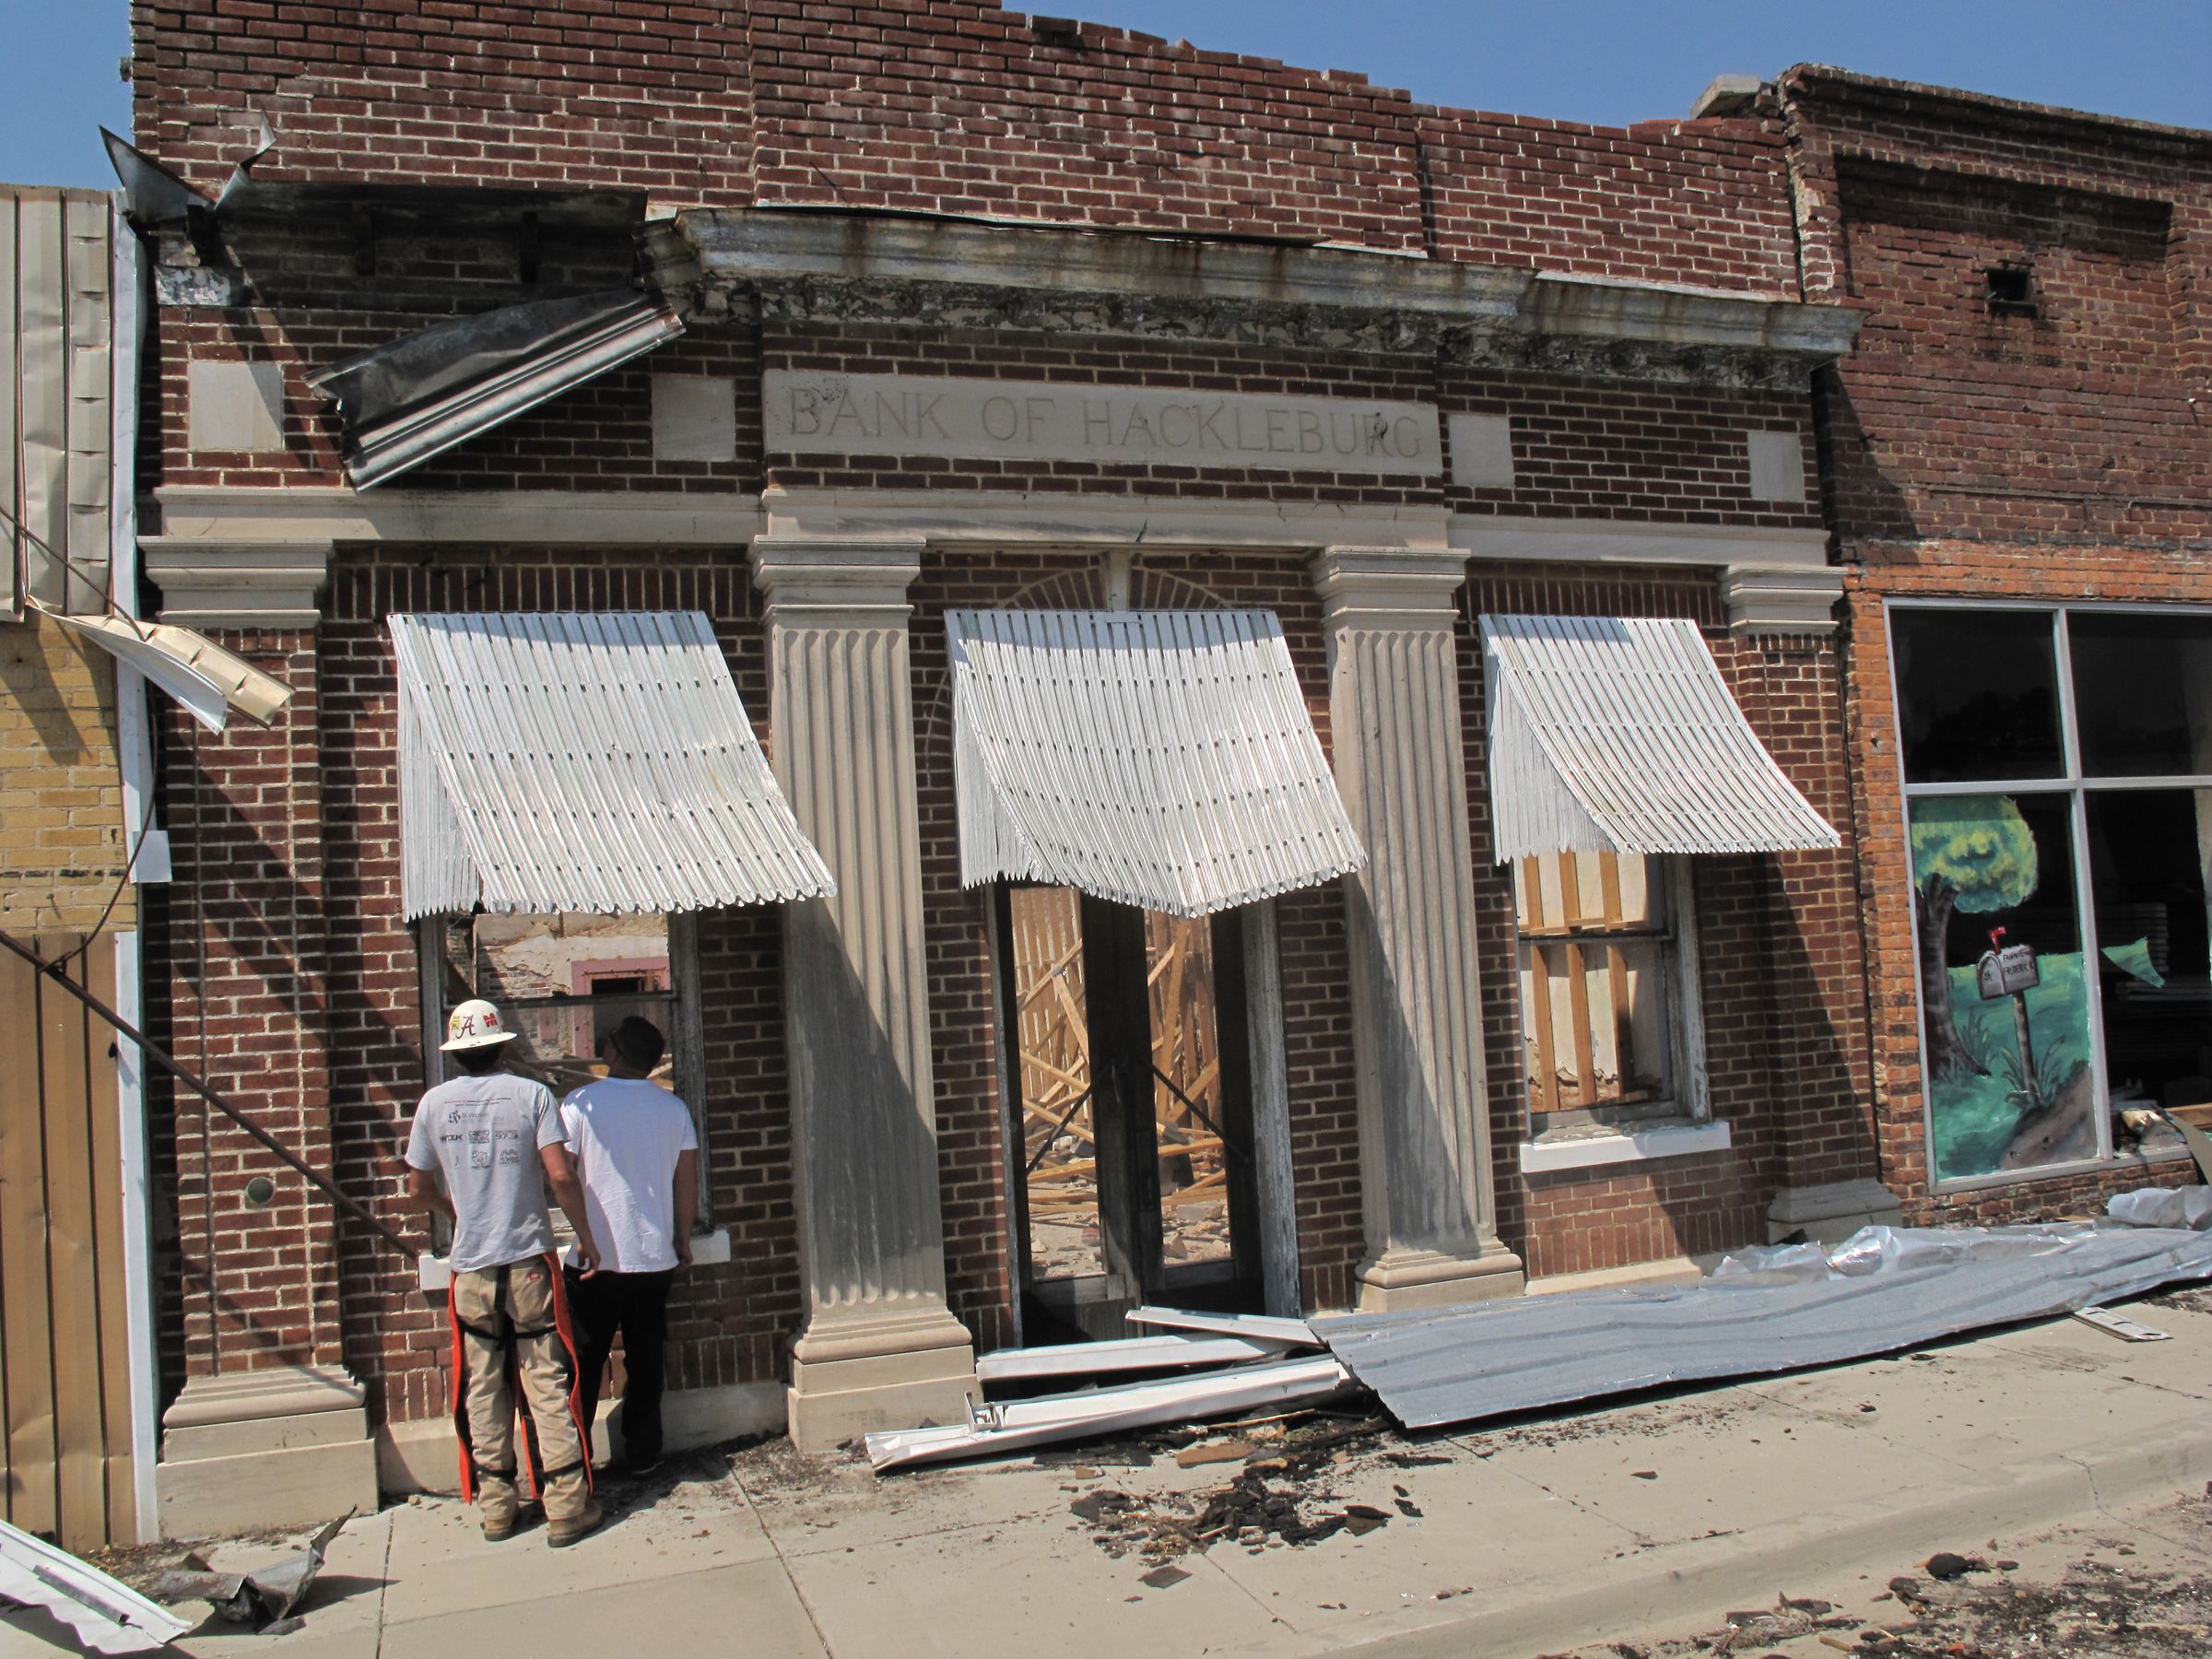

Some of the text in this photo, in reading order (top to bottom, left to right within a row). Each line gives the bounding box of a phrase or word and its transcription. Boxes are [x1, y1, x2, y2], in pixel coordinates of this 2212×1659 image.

[789, 385, 1423, 459] BANK OF HACKLEBURG
